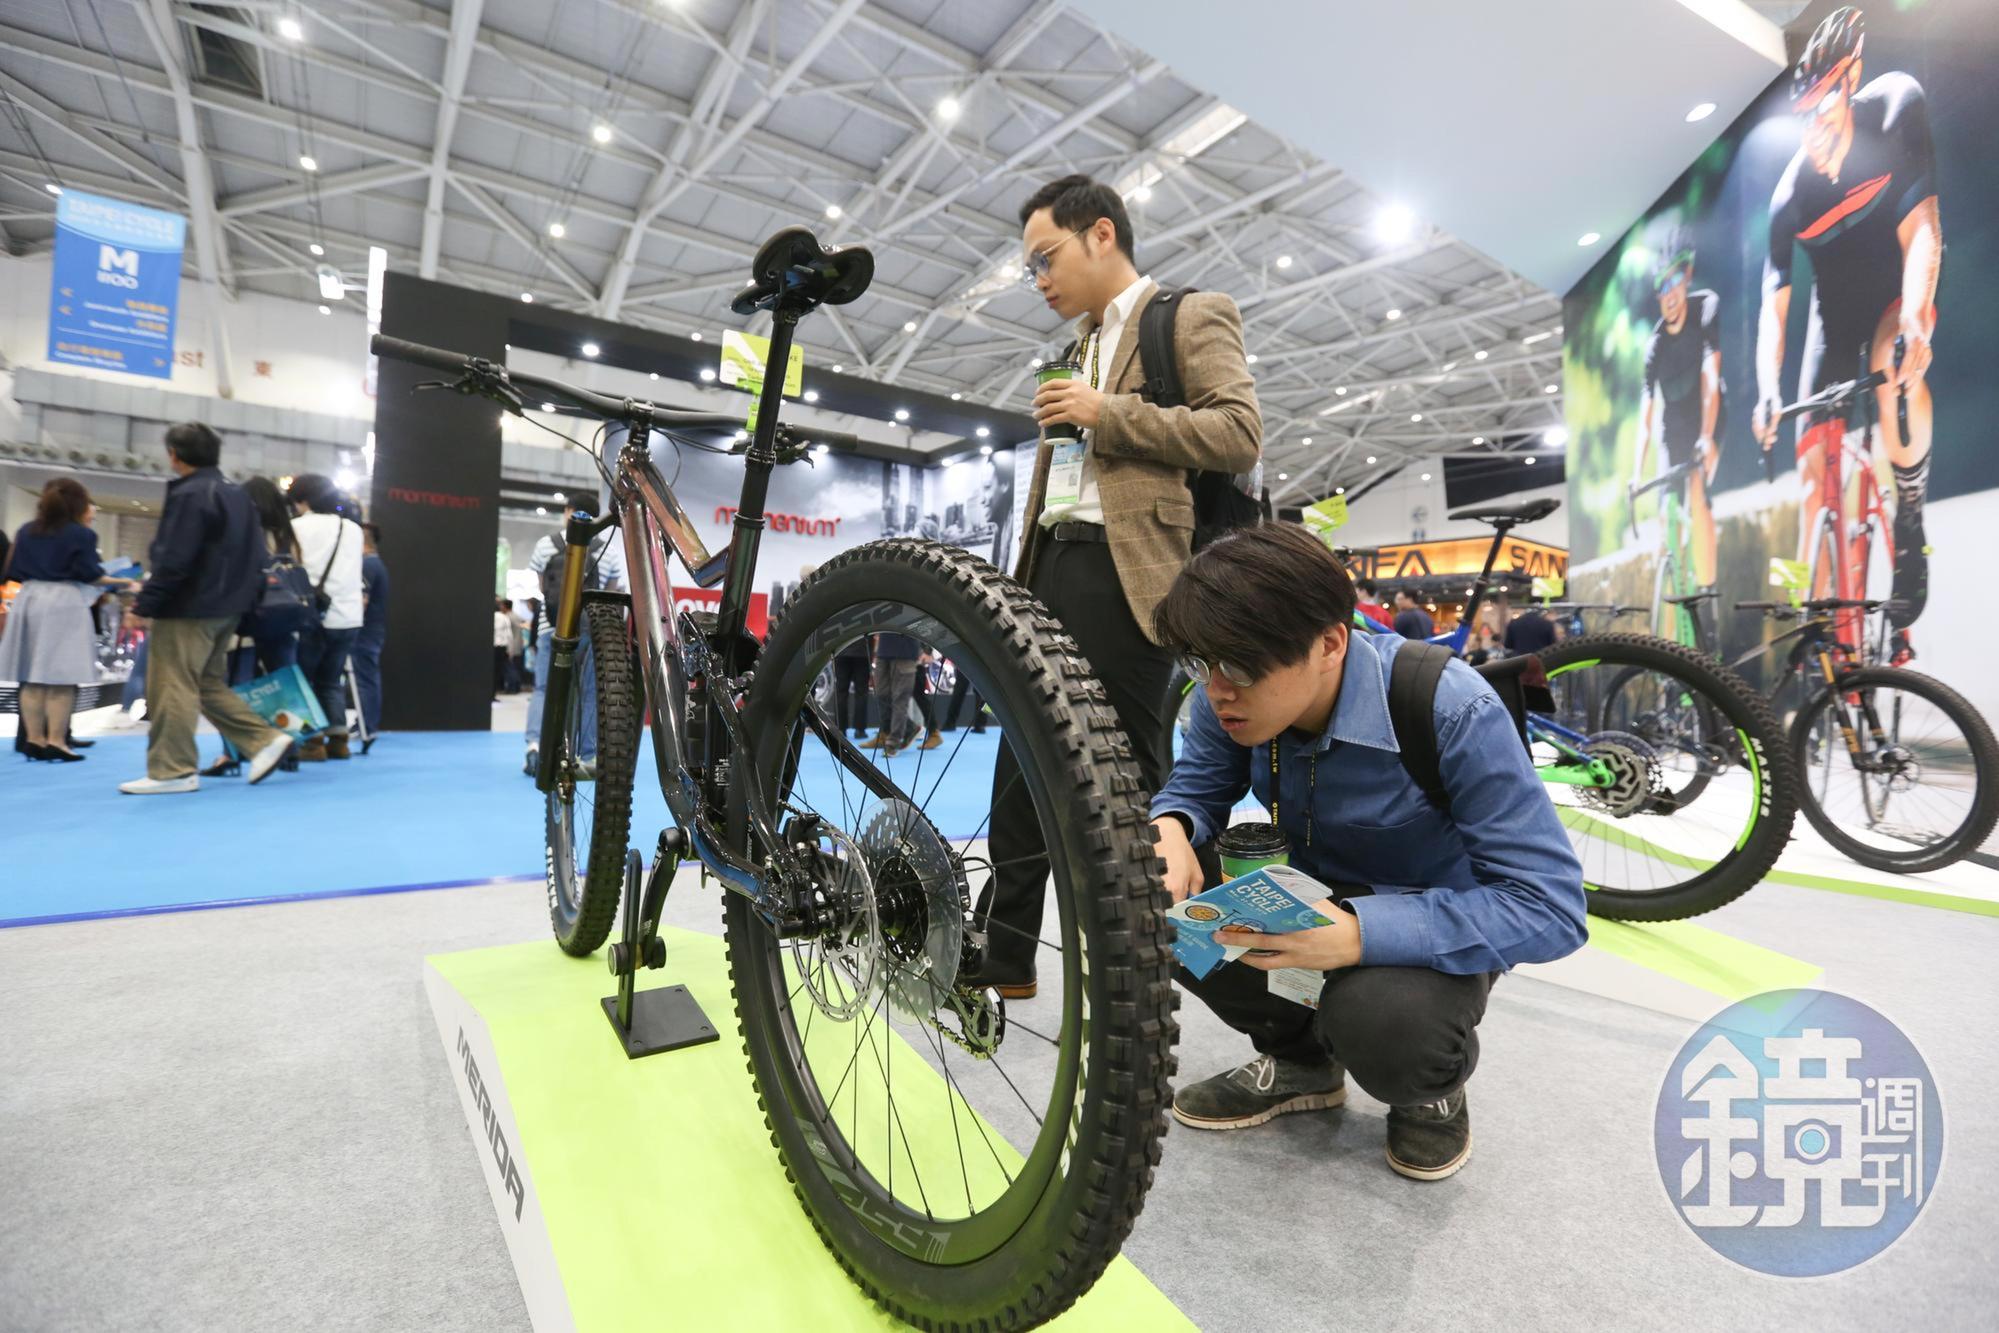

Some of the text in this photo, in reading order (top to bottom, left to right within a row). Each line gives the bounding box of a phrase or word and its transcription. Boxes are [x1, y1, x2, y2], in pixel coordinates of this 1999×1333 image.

[99, 244, 139, 278] M
[714, 506, 840, 538] mmentum
[1511, 544, 1568, 578] SAN
[1750, 737, 1772, 818] MAXXIS
[1236, 885, 1282, 914] CYCLE
[1250, 878, 1295, 909] TAIPEI
[456, 1024, 525, 1225] MERIDA
